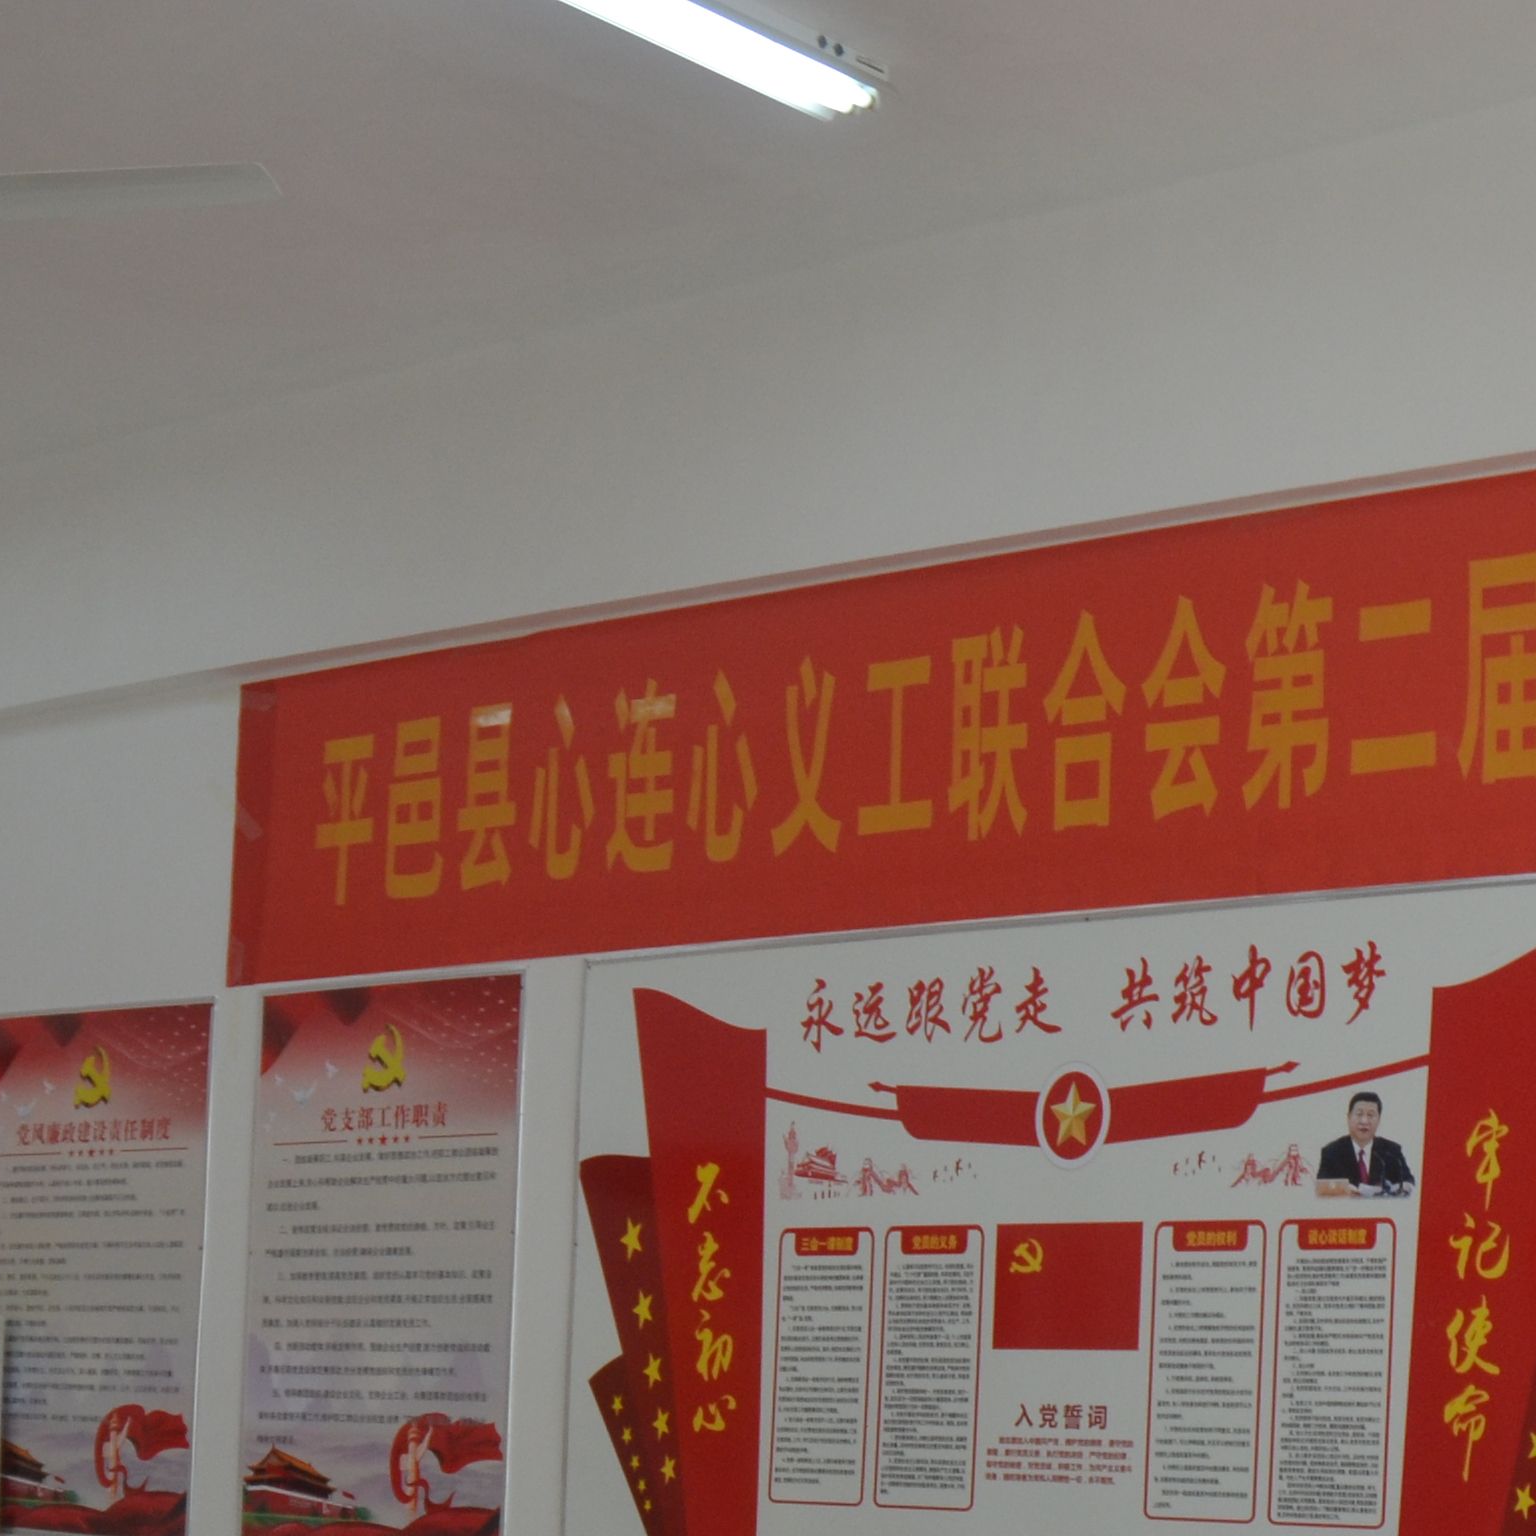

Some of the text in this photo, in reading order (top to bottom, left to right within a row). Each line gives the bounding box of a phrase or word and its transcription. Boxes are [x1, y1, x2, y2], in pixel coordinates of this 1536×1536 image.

[799, 940, 1388, 1054] 永远跟党走 共筑中国梦
[17, 1117, 171, 1146] 党风廉政建设责任制度
[321, 1101, 448, 1132] 党支部工作职责
[687, 1162, 737, 1432] 不忘初心
[1444, 1108, 1509, 1482] 牢记使命
[1014, 1403, 1108, 1430] 入党誓词
